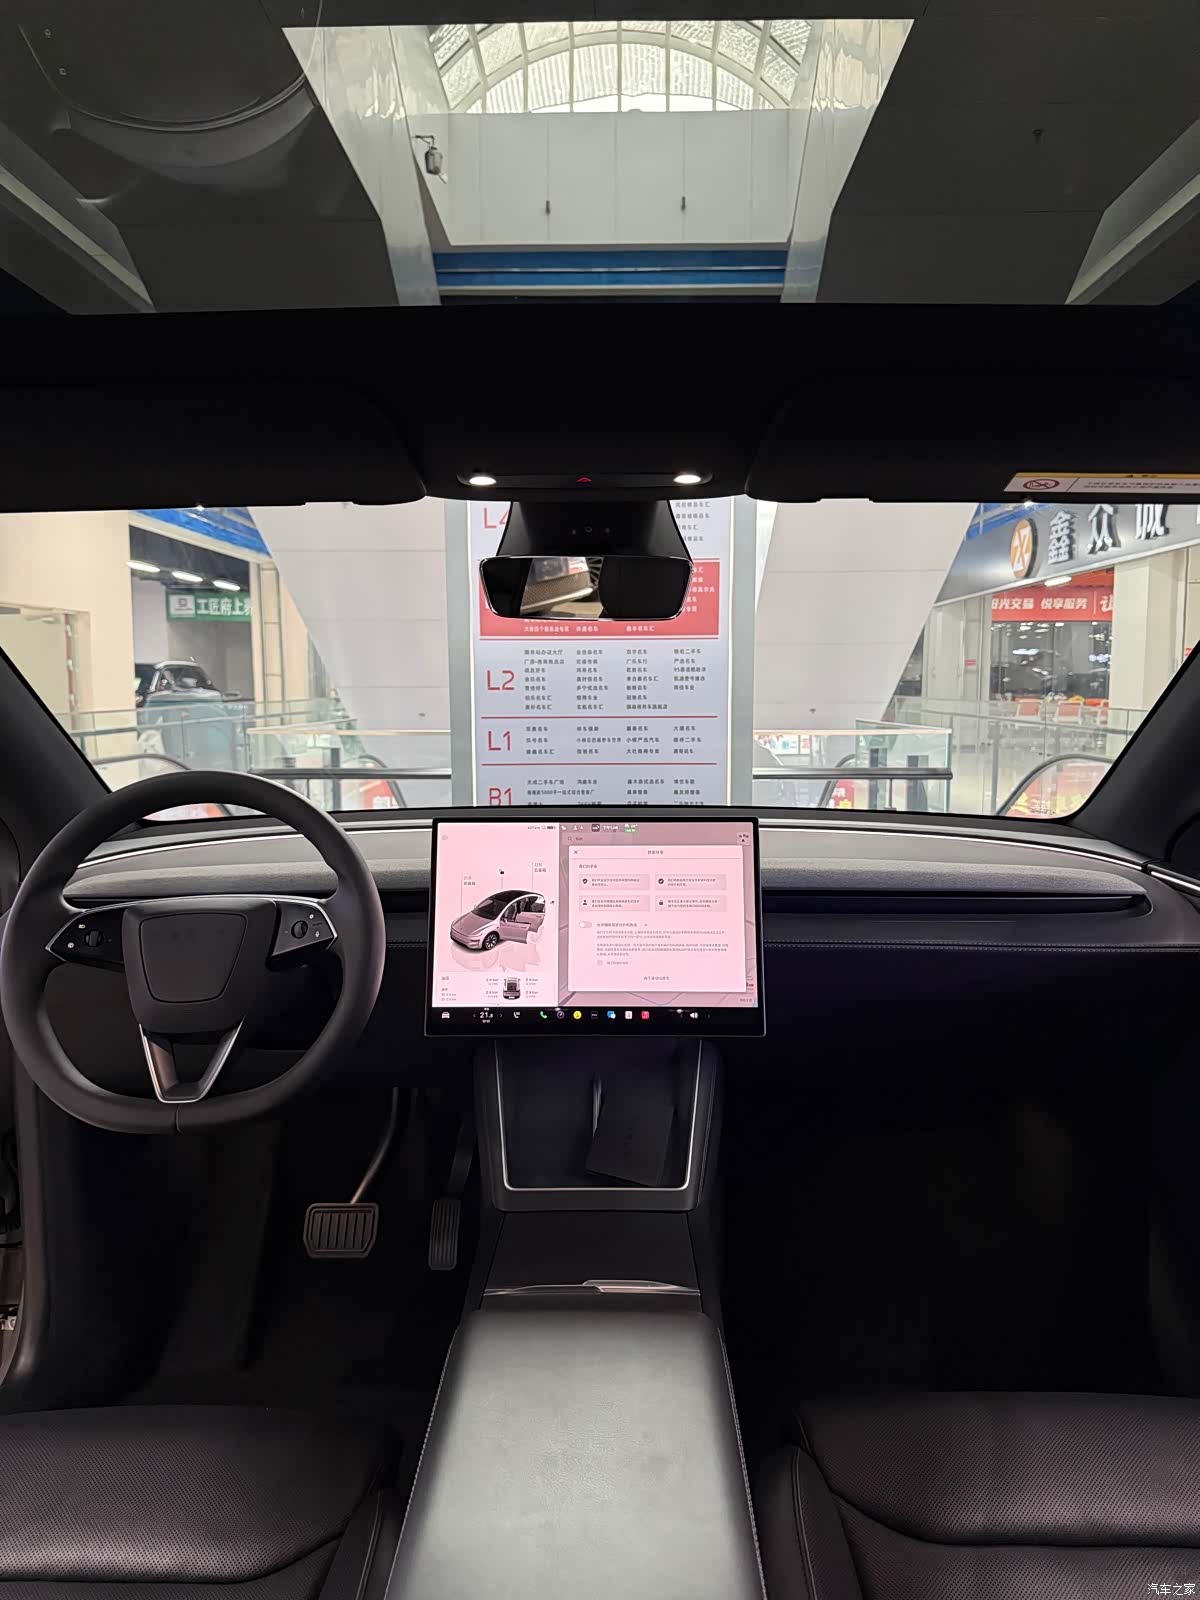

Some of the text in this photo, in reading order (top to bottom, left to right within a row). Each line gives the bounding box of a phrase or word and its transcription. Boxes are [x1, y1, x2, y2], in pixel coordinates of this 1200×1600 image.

[1040, 598, 1088, 610] 悦享服务
[487, 670, 515, 691] L2
[488, 730, 510, 751] L1
